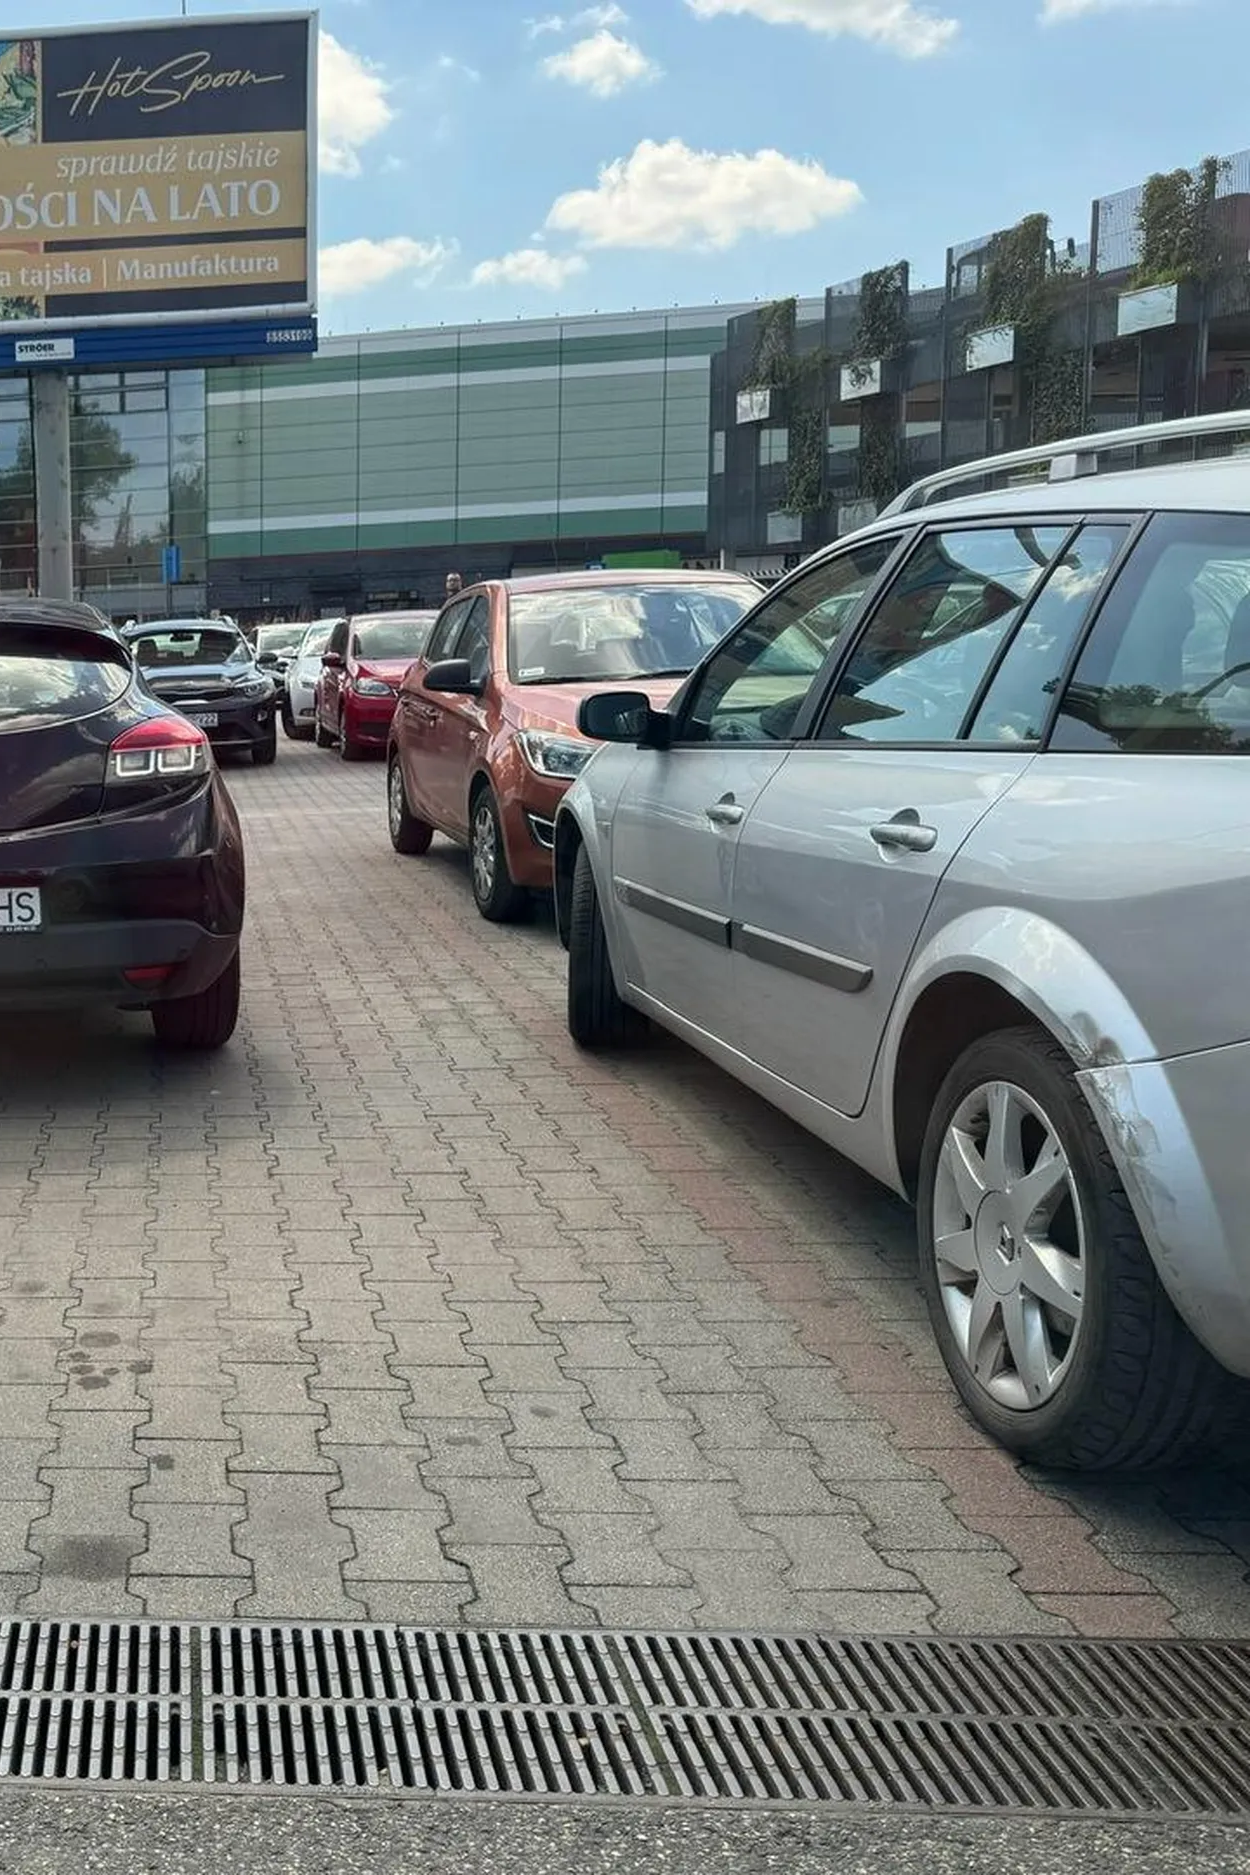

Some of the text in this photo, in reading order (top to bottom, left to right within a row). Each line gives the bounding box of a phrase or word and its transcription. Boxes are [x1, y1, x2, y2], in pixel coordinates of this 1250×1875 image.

[56, 141, 281, 183] sprawdź tajskie
[93, 186, 159, 226] NA
[168, 179, 281, 222] LATO
[19, 262, 92, 290] tajska
[116, 253, 280, 282] Manufaktura
